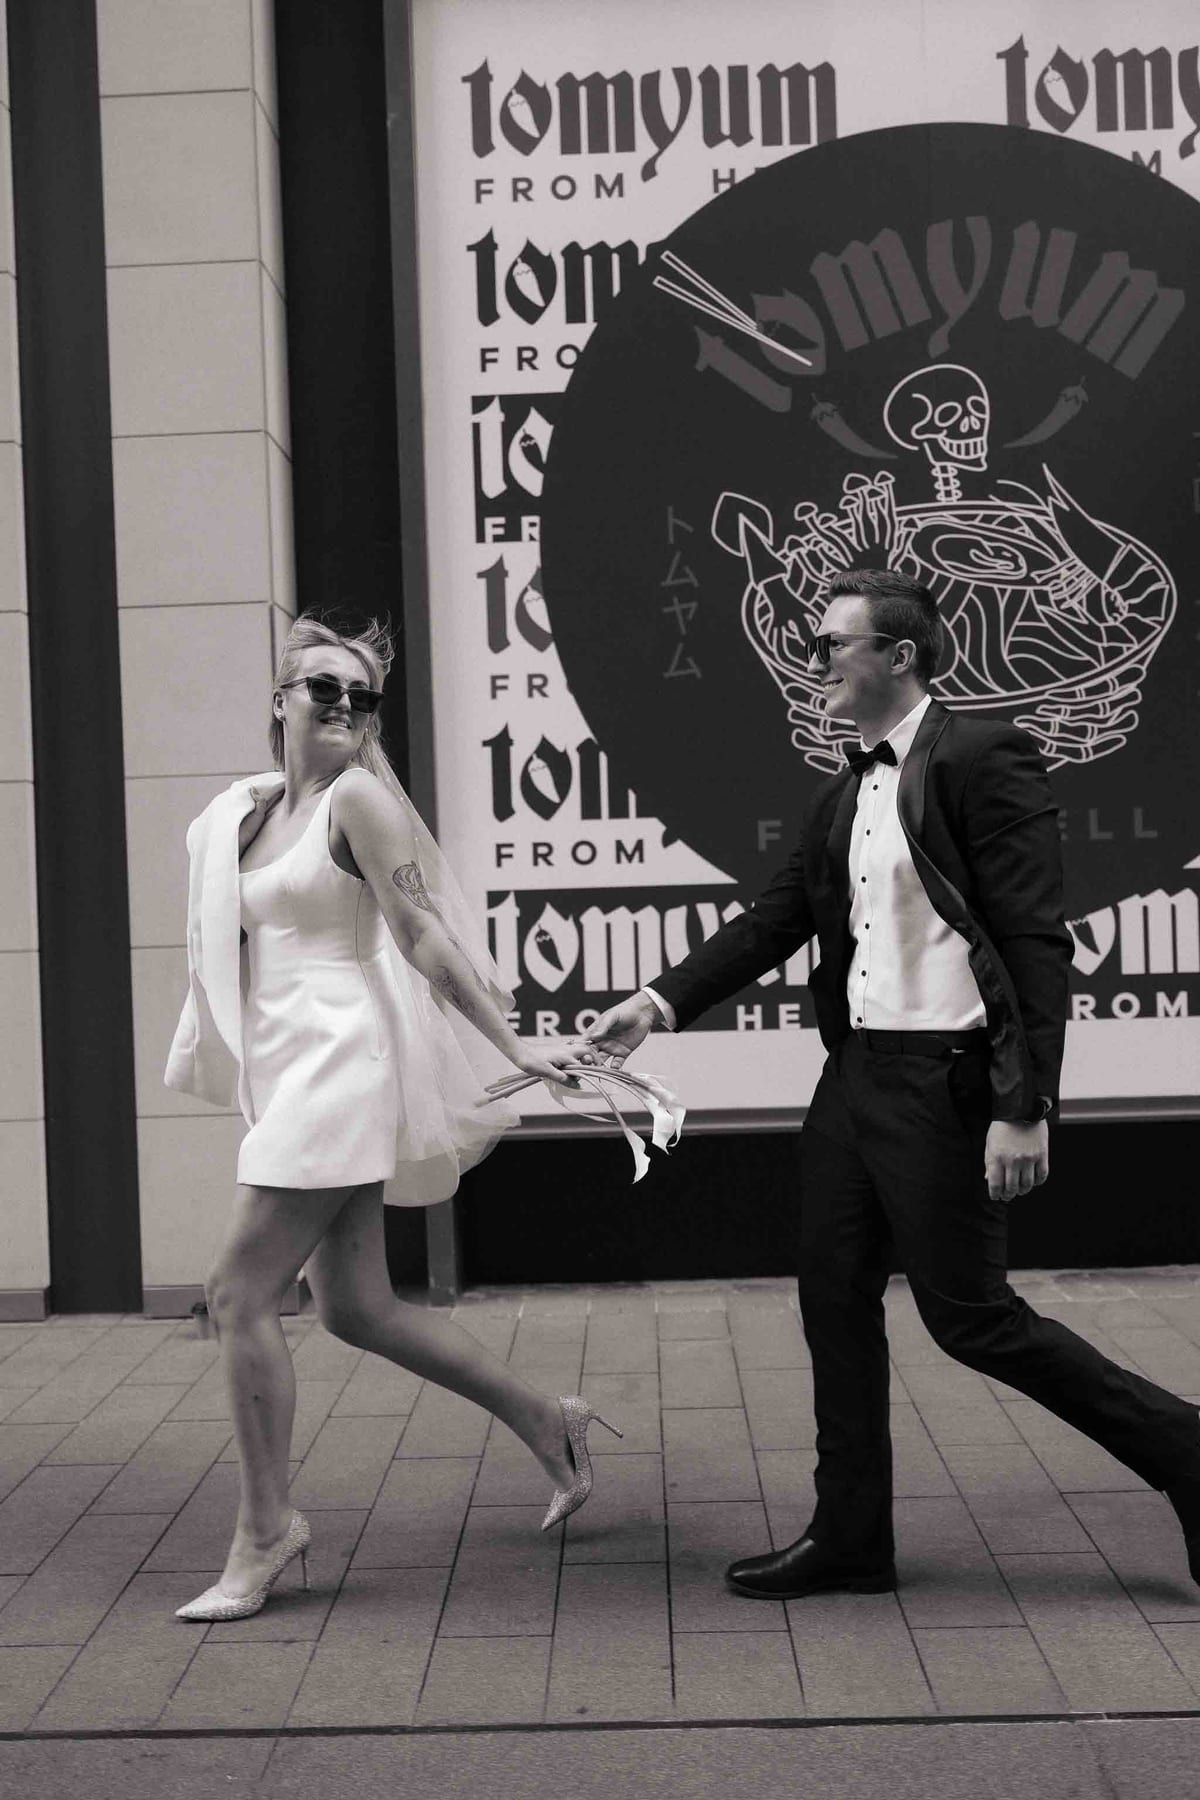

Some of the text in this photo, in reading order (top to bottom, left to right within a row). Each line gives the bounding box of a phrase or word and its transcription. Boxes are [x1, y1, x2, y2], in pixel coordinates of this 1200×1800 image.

[461, 57, 838, 183] tomyum
[474, 172, 626, 204] FROM
[694, 214, 1186, 413] tomyum
[495, 839, 645, 868] FROM
